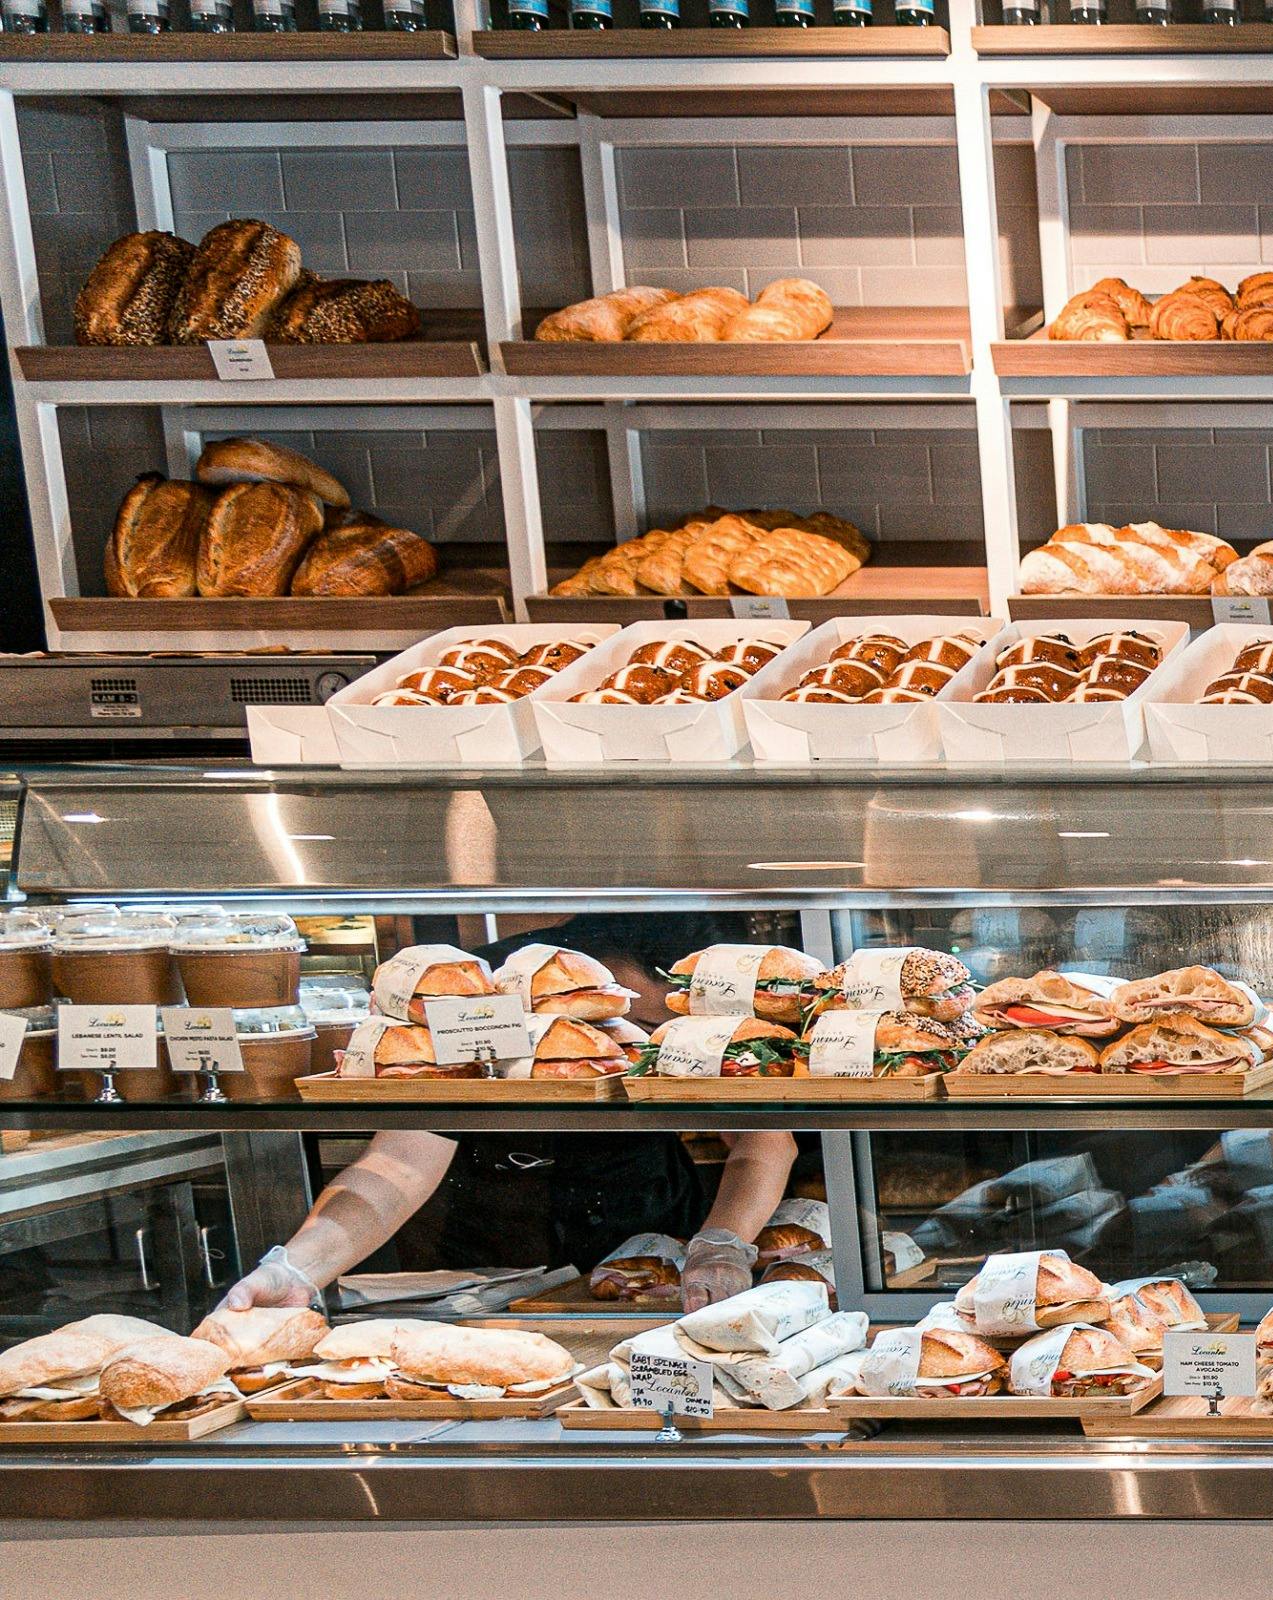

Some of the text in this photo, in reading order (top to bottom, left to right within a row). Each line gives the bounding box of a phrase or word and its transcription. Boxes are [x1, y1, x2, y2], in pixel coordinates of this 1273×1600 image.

[437, 1027, 473, 1035] PROSCIUTTO
[474, 1024, 511, 1033] BOCCONCINI
[1191, 1345, 1226, 1356] Locantro
[632, 1354, 688, 1369] BABY SPINACH
[631, 1365, 688, 1377] SCRAMBLED EGG
[632, 1373, 653, 1382] WRAP
[647, 1379, 697, 1397] Locantro
[633, 1397, 653, 1406] $9.90
